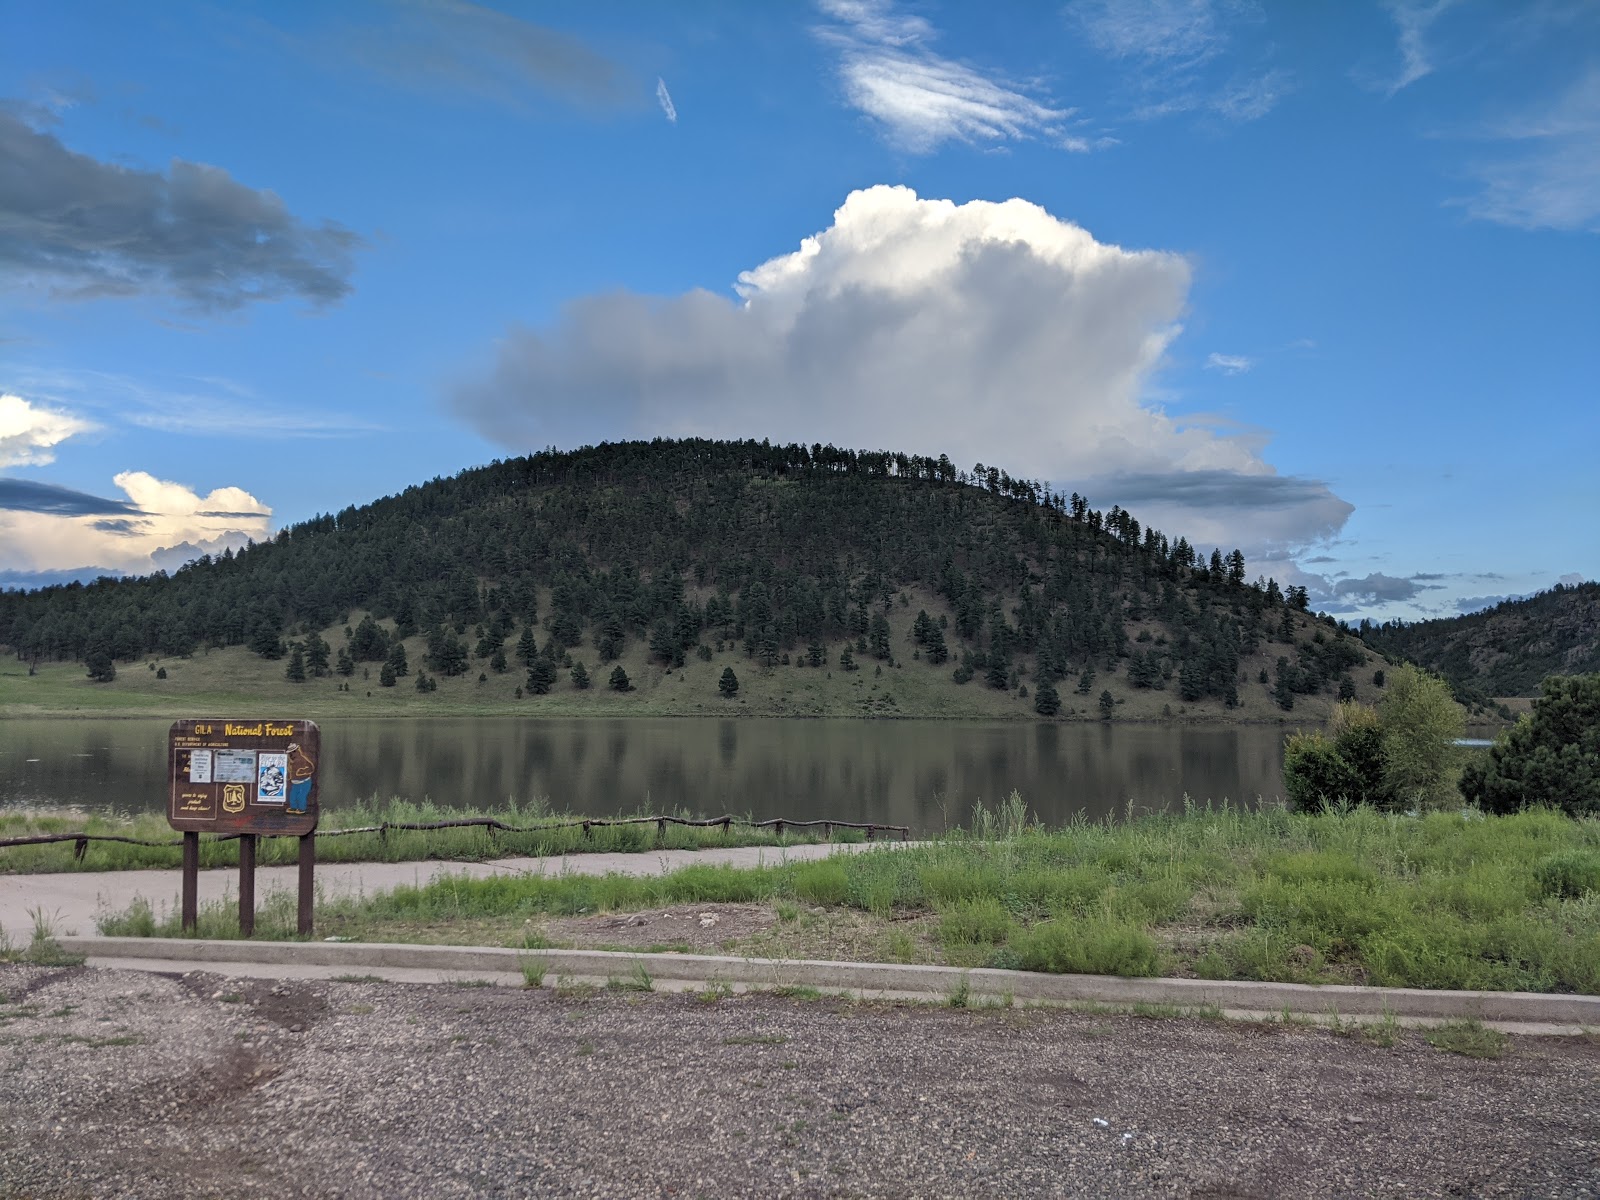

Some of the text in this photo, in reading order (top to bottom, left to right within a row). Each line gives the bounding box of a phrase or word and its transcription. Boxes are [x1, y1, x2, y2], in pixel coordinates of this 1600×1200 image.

[195, 723, 294, 736] GILA National Forest
